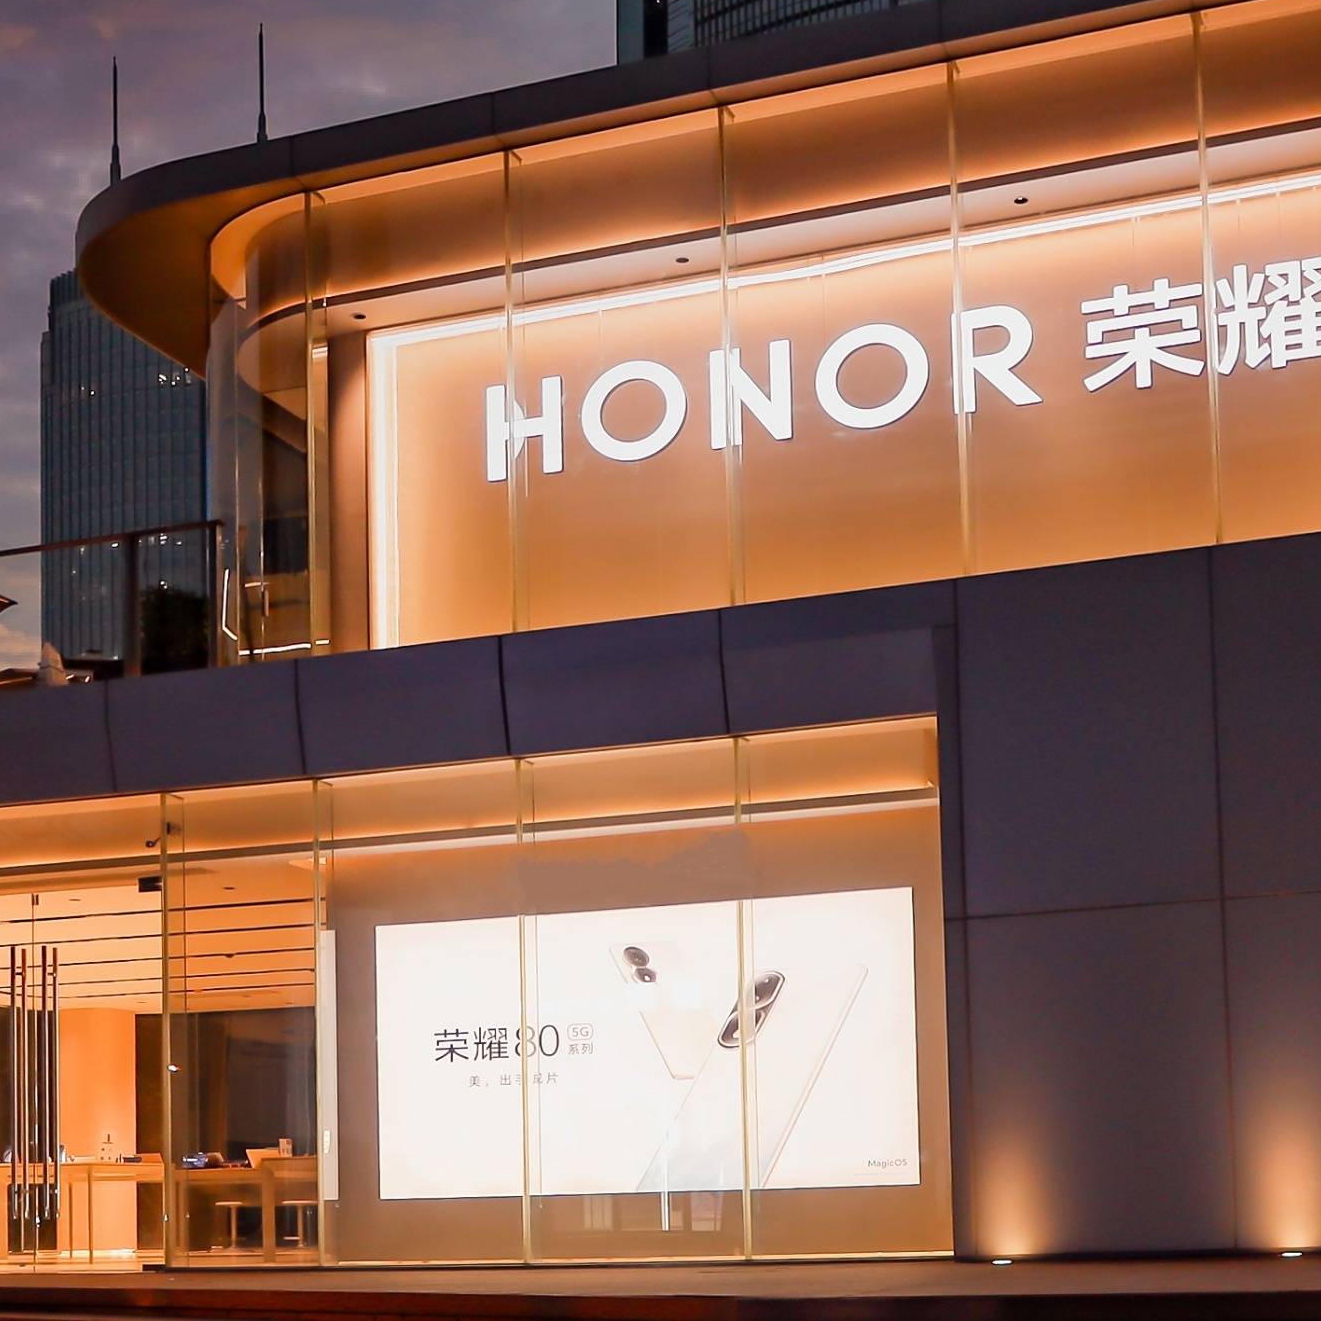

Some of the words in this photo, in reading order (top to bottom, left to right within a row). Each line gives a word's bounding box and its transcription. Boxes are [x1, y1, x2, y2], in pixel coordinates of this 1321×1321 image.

[484, 303, 1044, 484] HONOR
[571, 1027, 589, 1038] 5G
[433, 1024, 560, 1063] 荣耀80
[568, 1043, 594, 1055] 系列
[867, 1158, 908, 1169] MagicOS
